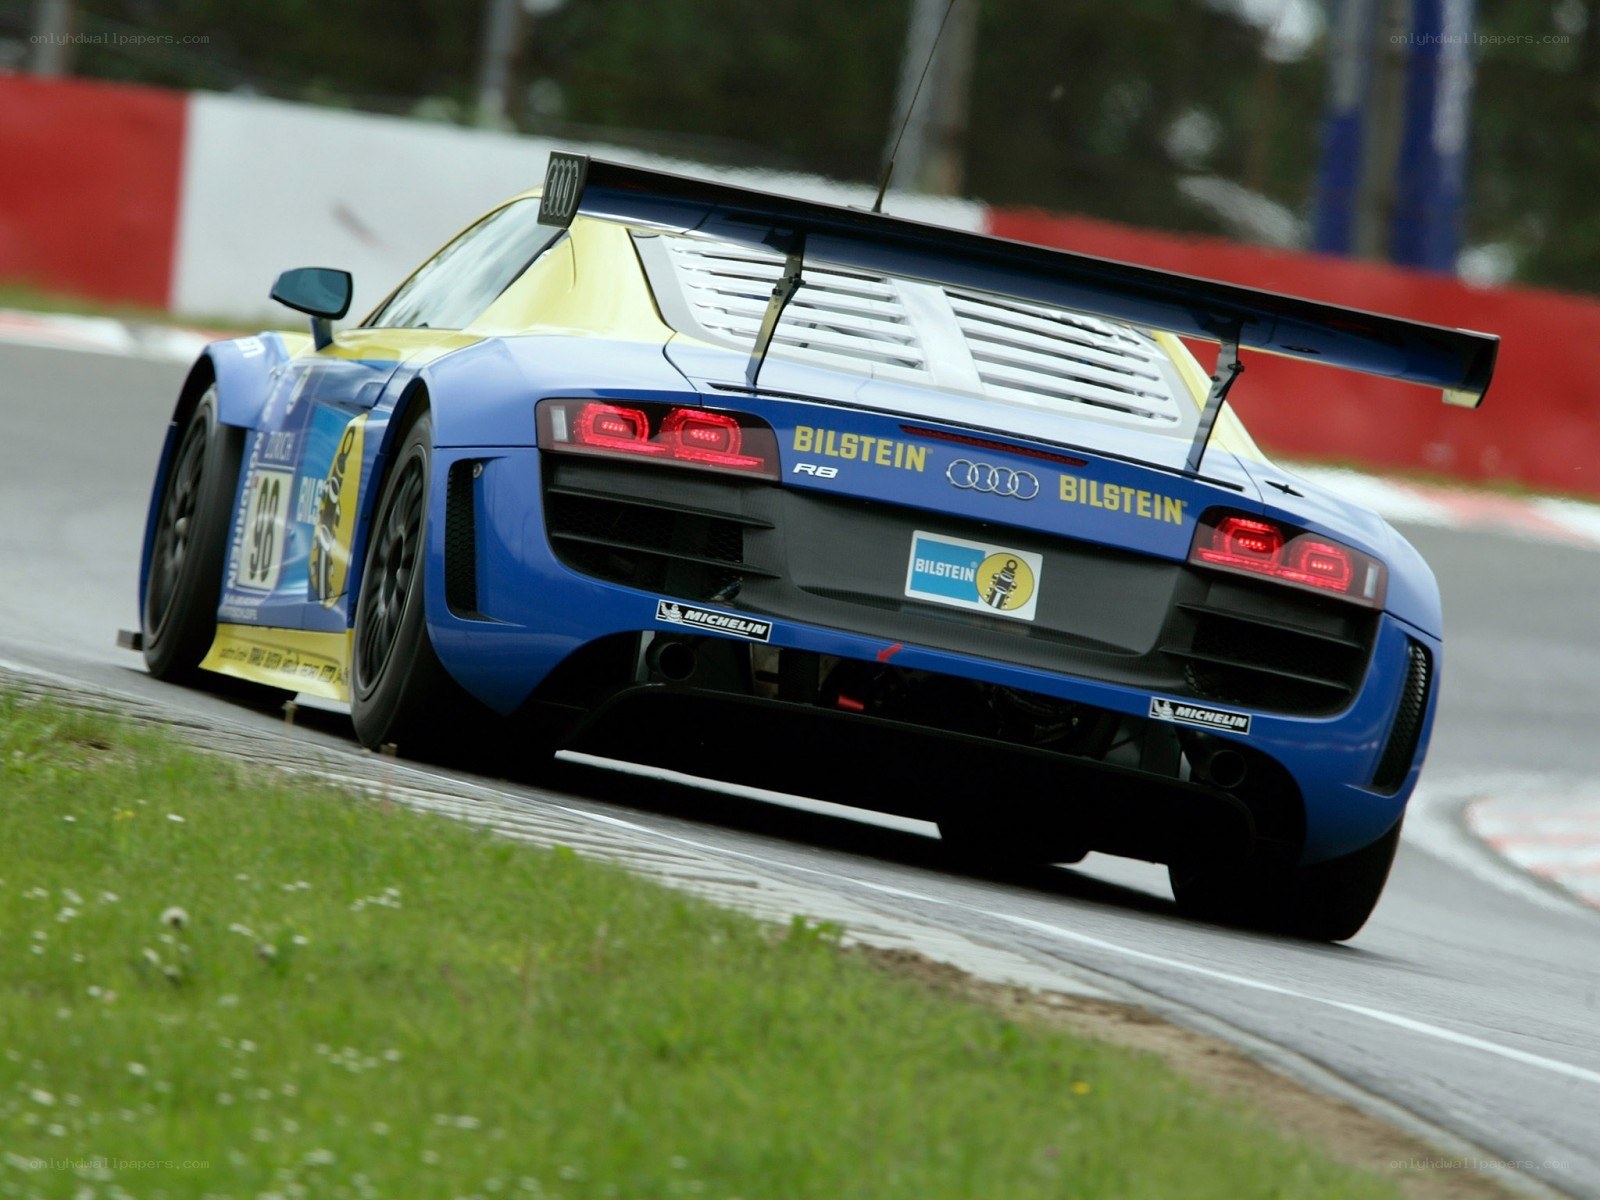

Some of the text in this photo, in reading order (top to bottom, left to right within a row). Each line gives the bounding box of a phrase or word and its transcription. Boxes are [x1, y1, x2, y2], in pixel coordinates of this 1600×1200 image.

[793, 425, 926, 473] BILSTEIN
[793, 462, 839, 479] R8
[1059, 474, 1183, 526] BILSTEIN
[915, 558, 975, 583] BILSTEIN
[684, 610, 768, 635] MICHELIN
[1175, 706, 1248, 728] MICHELIN
